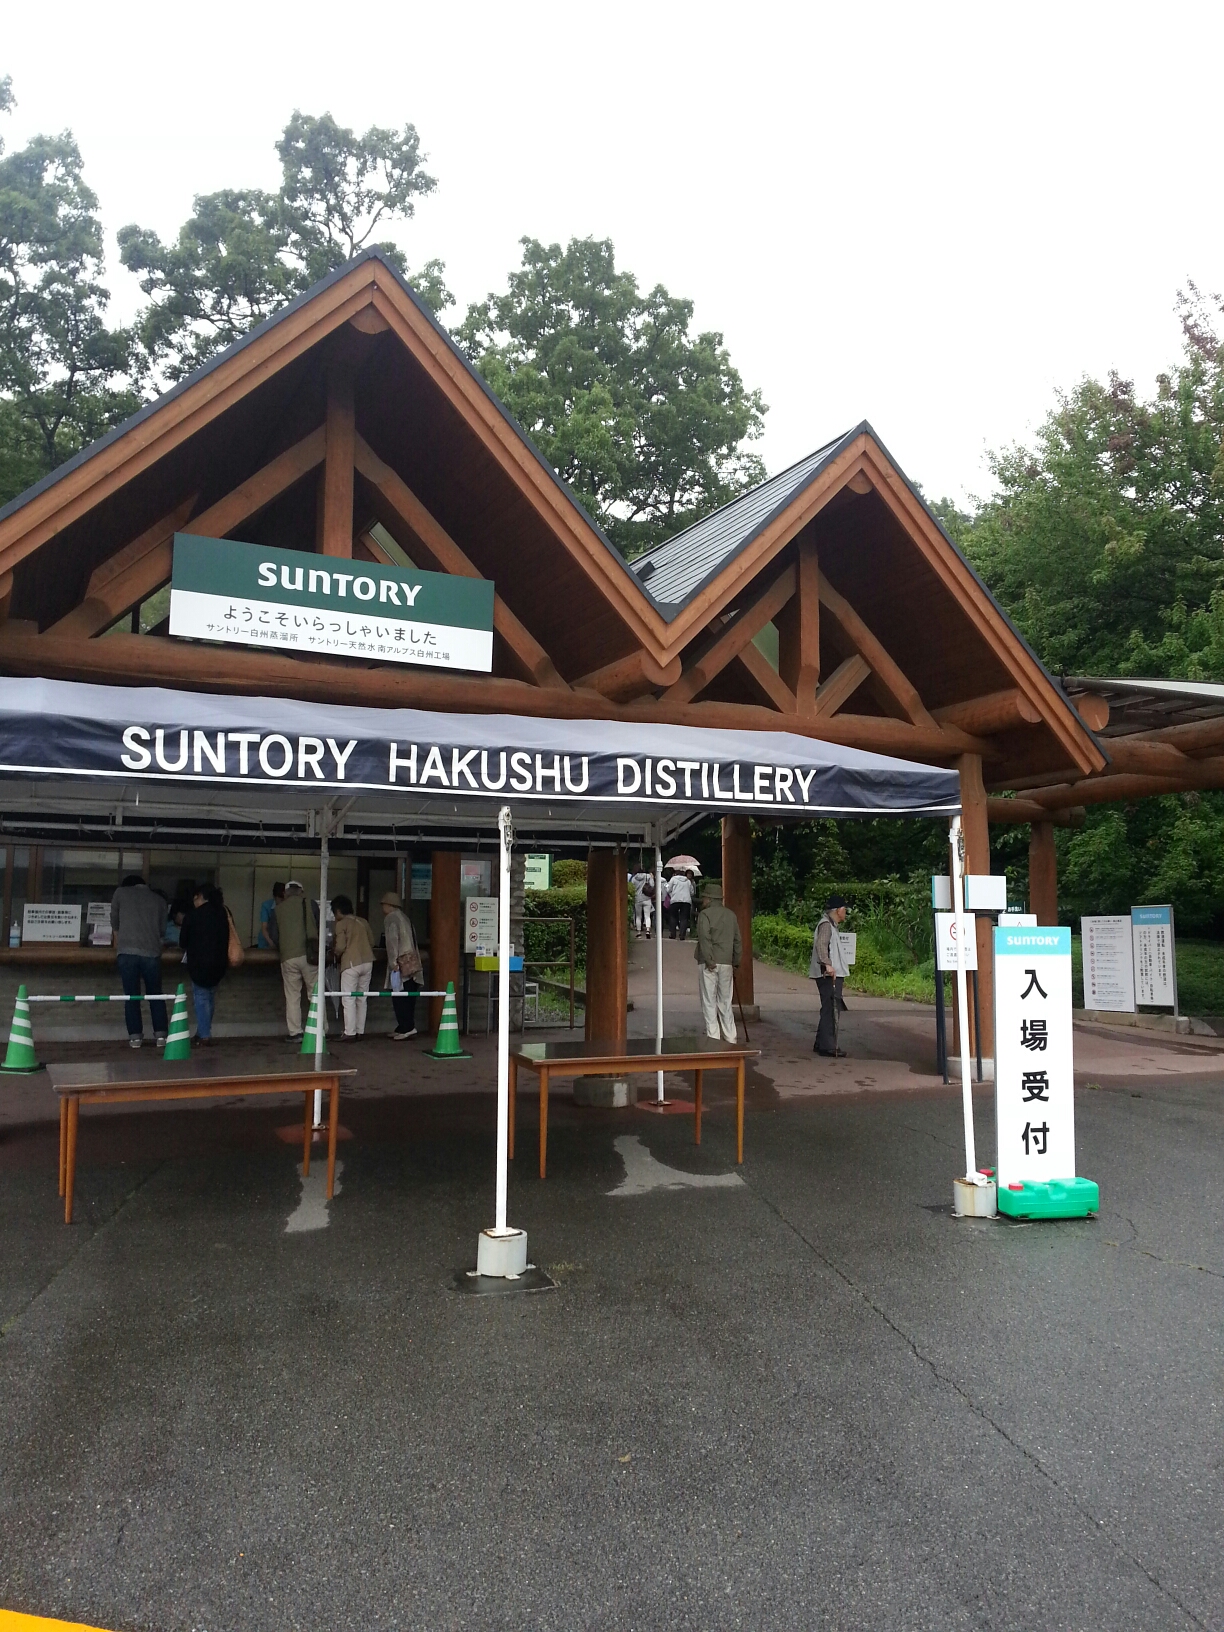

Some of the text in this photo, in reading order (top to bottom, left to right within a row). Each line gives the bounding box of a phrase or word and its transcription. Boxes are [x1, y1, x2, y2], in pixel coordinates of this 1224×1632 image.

[224, 605, 437, 646] ようこそいらっしゃいました
[120, 725, 817, 803] SUNTORY HAKUSHU DISTILLERY
[1020, 969, 1050, 1156] 入場受付
